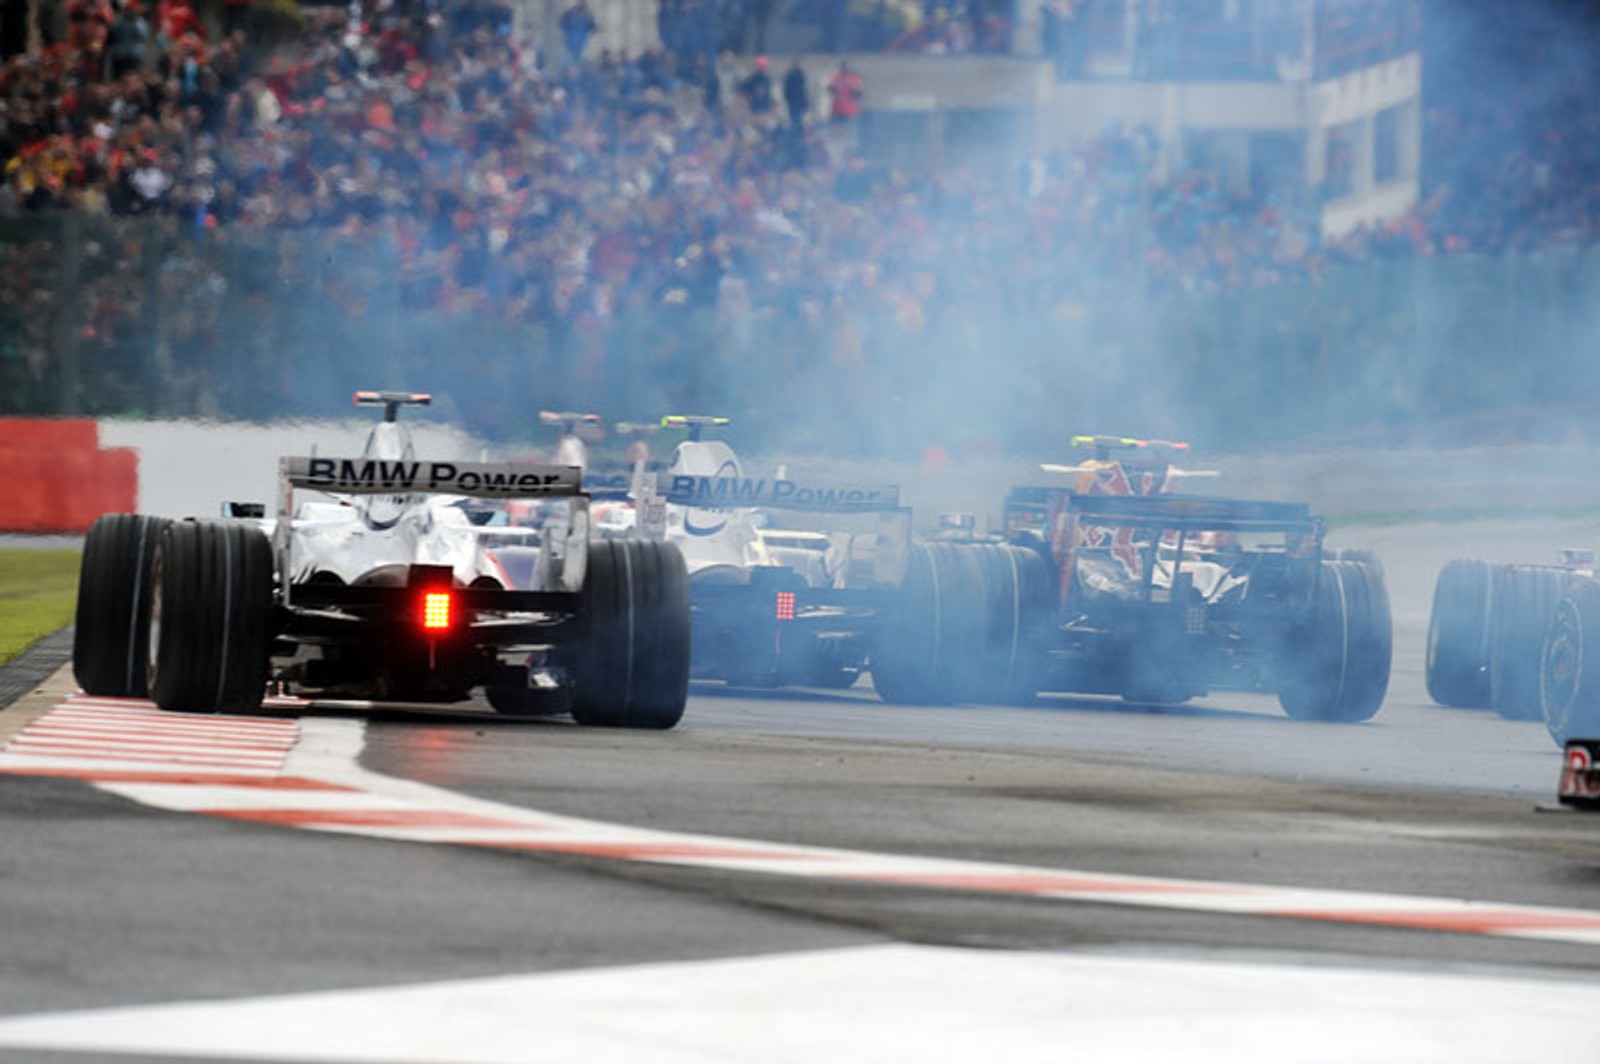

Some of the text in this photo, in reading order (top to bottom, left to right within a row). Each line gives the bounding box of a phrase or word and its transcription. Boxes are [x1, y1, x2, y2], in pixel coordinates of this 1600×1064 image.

[307, 458, 420, 488] BMW
[430, 463, 560, 493] Power
[671, 475, 881, 507] BMW Power
